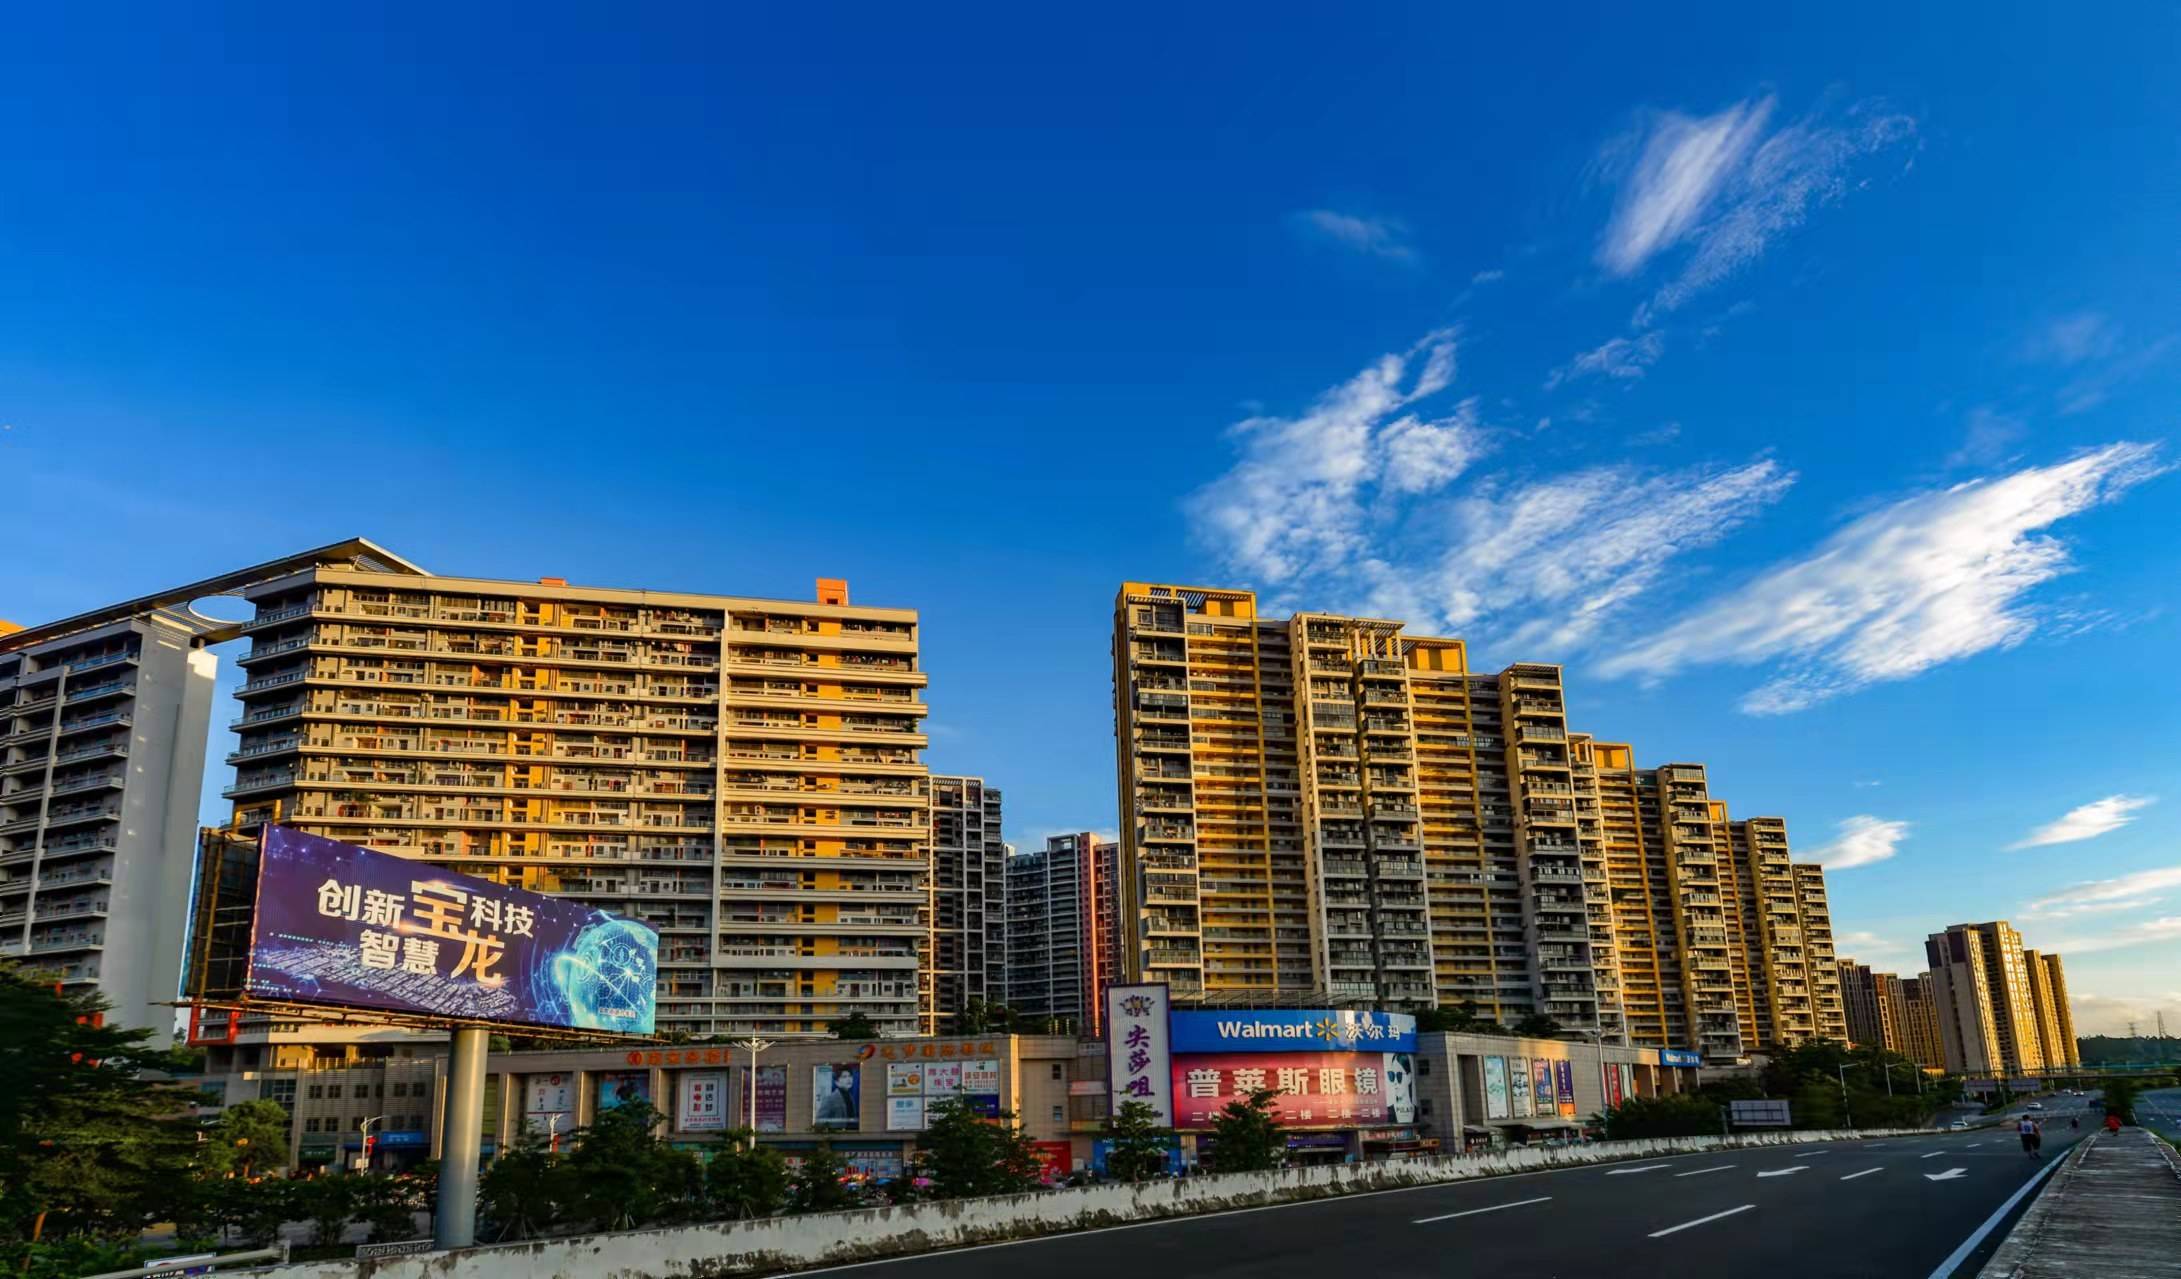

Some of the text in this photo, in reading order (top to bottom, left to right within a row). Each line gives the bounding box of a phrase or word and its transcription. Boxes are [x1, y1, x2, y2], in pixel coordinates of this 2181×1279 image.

[1217, 1021, 1400, 1040] Walmart 沃尔玛
[1188, 1067, 1378, 1098] 普莱斯眼镜
